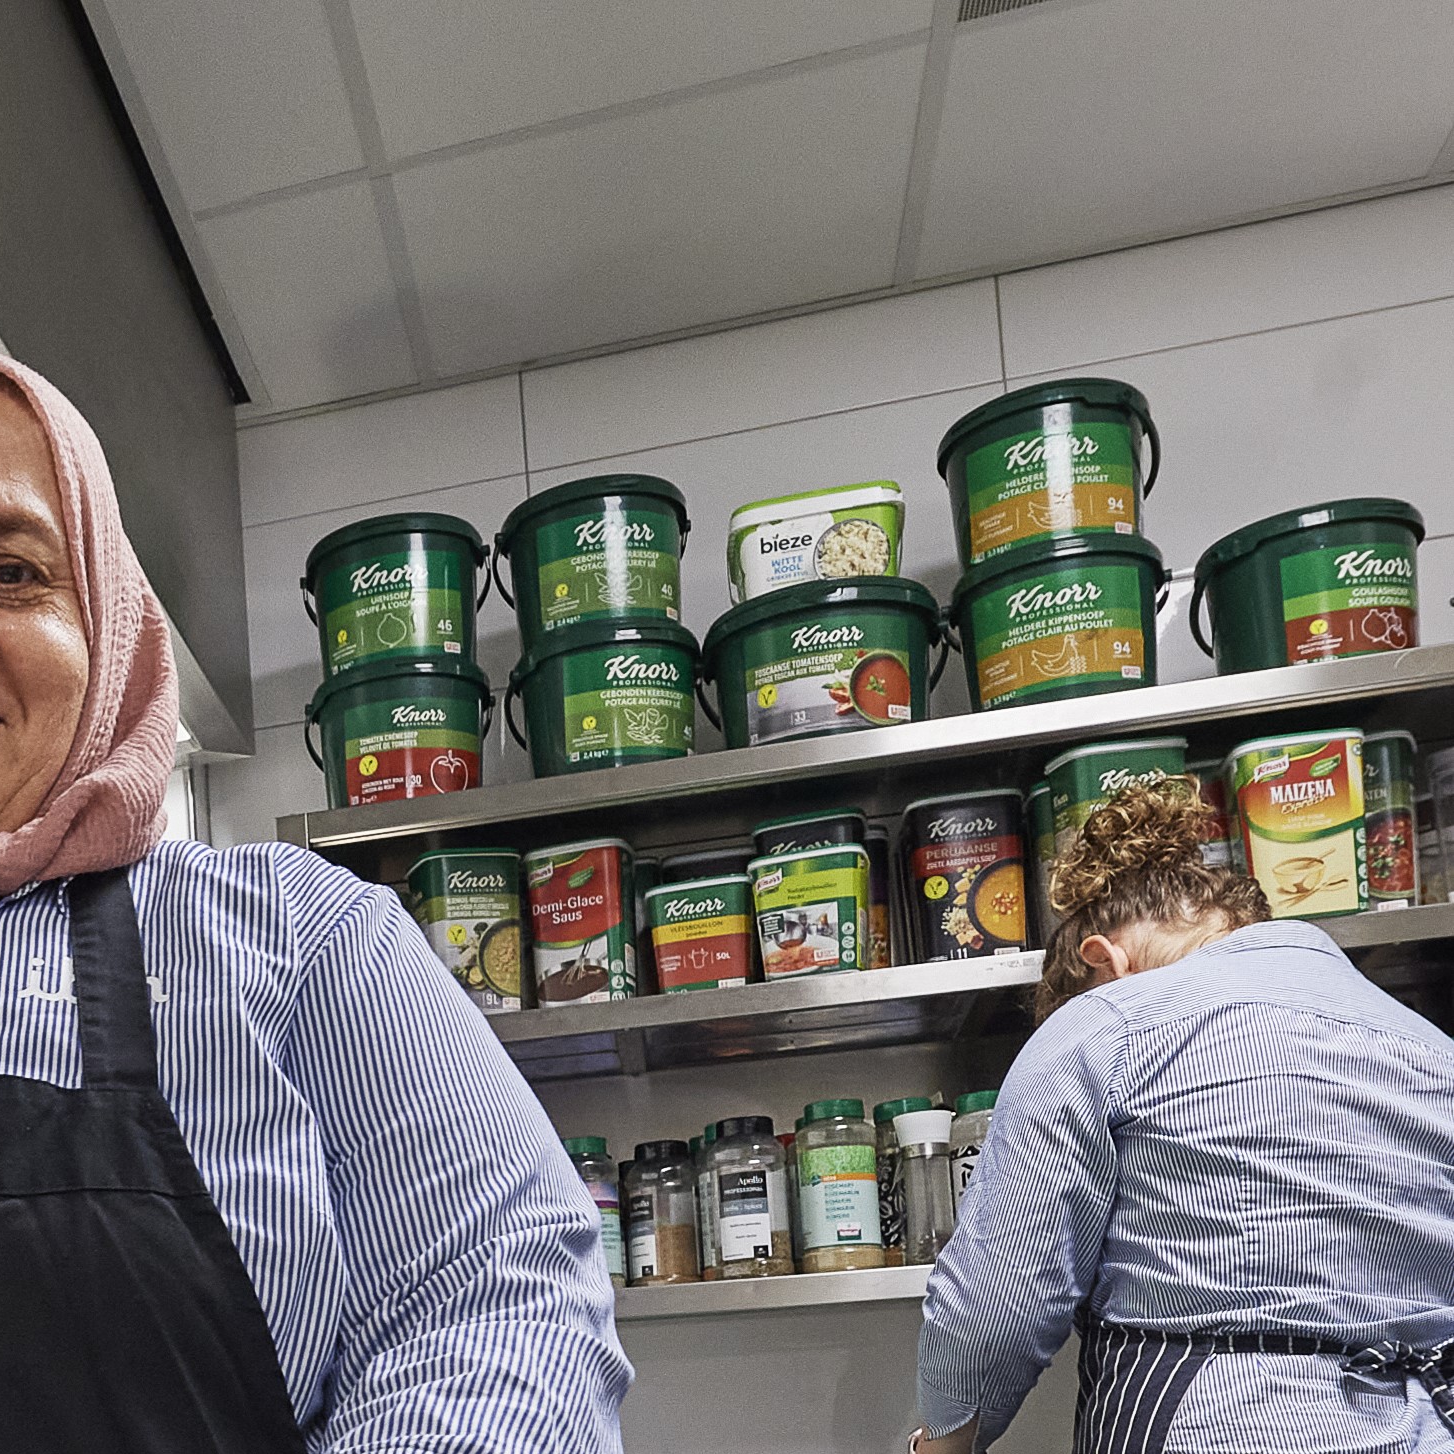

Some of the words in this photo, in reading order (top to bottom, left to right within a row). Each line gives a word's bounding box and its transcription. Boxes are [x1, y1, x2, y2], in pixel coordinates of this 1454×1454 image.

[1004, 435, 1099, 470] Knrr
[998, 485, 1032, 501] POTAGE
[1076, 474, 1109, 484] POULET
[1006, 472, 1044, 489] HELDERE
[1107, 497, 1124, 511] 94
[760, 534, 813, 554] bieze
[771, 555, 804, 568] WITTE
[774, 564, 801, 575] KOOL
[1334, 550, 1413, 579] Knorr
[661, 583, 673, 596] 40
[1006, 581, 1103, 619] Knorr
[1015, 602, 1095, 622] PROFESSIONAL
[437, 619, 453, 632] 46
[1008, 619, 1047, 638] HELDERE
[1048, 610, 1105, 626] KIPPENSOEP
[791, 624, 865, 649] Knorr
[1001, 633, 1034, 649] POTAGE
[1036, 626, 1063, 640] CLAIR
[1064, 623, 1079, 632] AU
[1079, 619, 1114, 630] POULET
[797, 641, 858, 653] PROFESSIONAL
[1113, 641, 1131, 655] 94
[604, 655, 680, 681] Knorr
[791, 653, 844, 669] TOMATENSOEP
[600, 688, 647, 699] GEBONDEN
[605, 698, 638, 707] POTAGE
[639, 697, 649, 705] AU
[391, 705, 447, 724] Knorr
[794, 710, 807, 723] 33
[1256, 759, 1287, 776] Knorr
[1270, 778, 1336, 805] MAIZENA
[927, 817, 998, 839] Knorr
[926, 842, 998, 860] PERUAANSE
[448, 870, 507, 889] Knorr
[532, 894, 604, 916] Demi-Glace
[664, 897, 726, 918] Knorr
[552, 910, 583, 924] Saus
[486, 993, 499, 1005] 9L
[738, 1175, 763, 1186] Apollo
